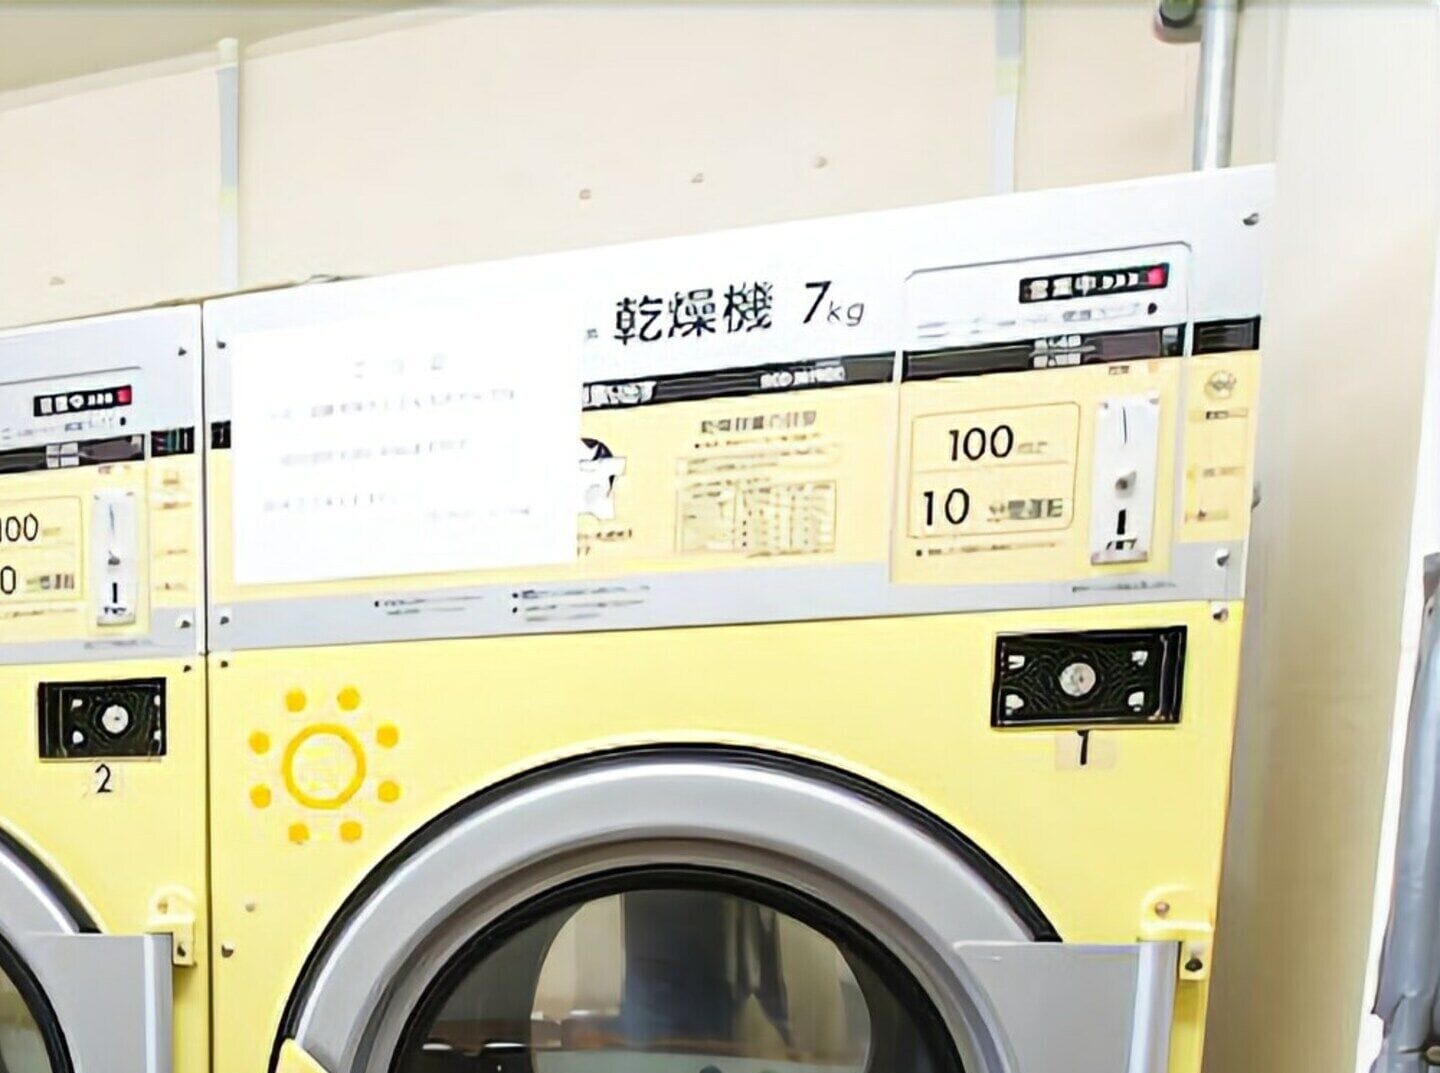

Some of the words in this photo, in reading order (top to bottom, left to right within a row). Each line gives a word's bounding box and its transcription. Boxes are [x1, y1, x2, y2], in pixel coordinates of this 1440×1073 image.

[612, 280, 774, 348] 乾燥機
[802, 279, 867, 329] 7kg
[947, 424, 1015, 462] 100
[923, 487, 970, 526] 10
[94, 763, 113, 794] 2
